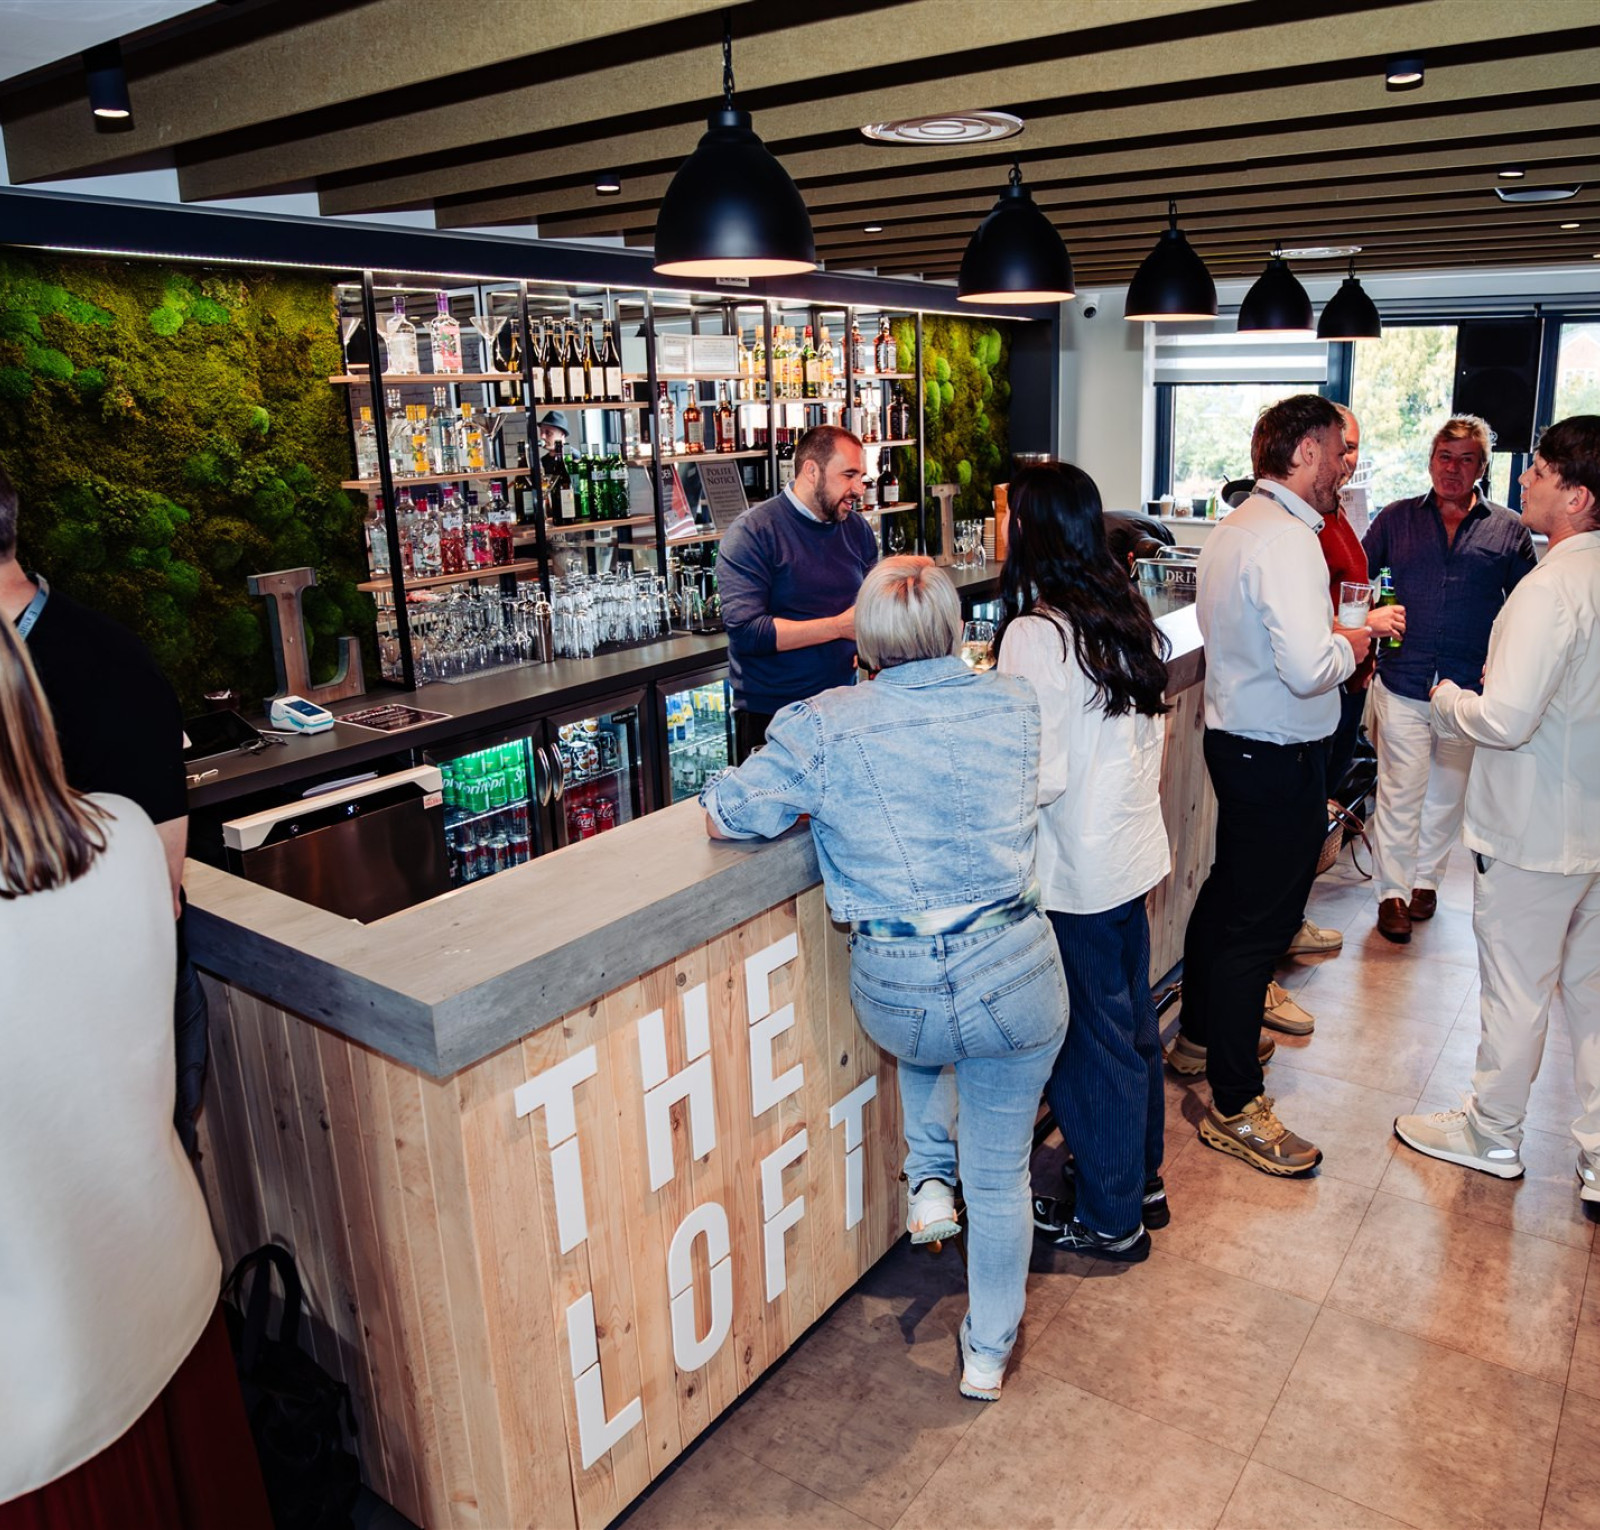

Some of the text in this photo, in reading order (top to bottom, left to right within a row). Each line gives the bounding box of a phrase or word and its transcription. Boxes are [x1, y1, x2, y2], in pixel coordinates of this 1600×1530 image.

[706, 467, 732, 476] POLITE
[706, 475, 737, 485] NOTICE
[514, 932, 804, 1255] THE
[566, 1075, 877, 1470] LOFT
